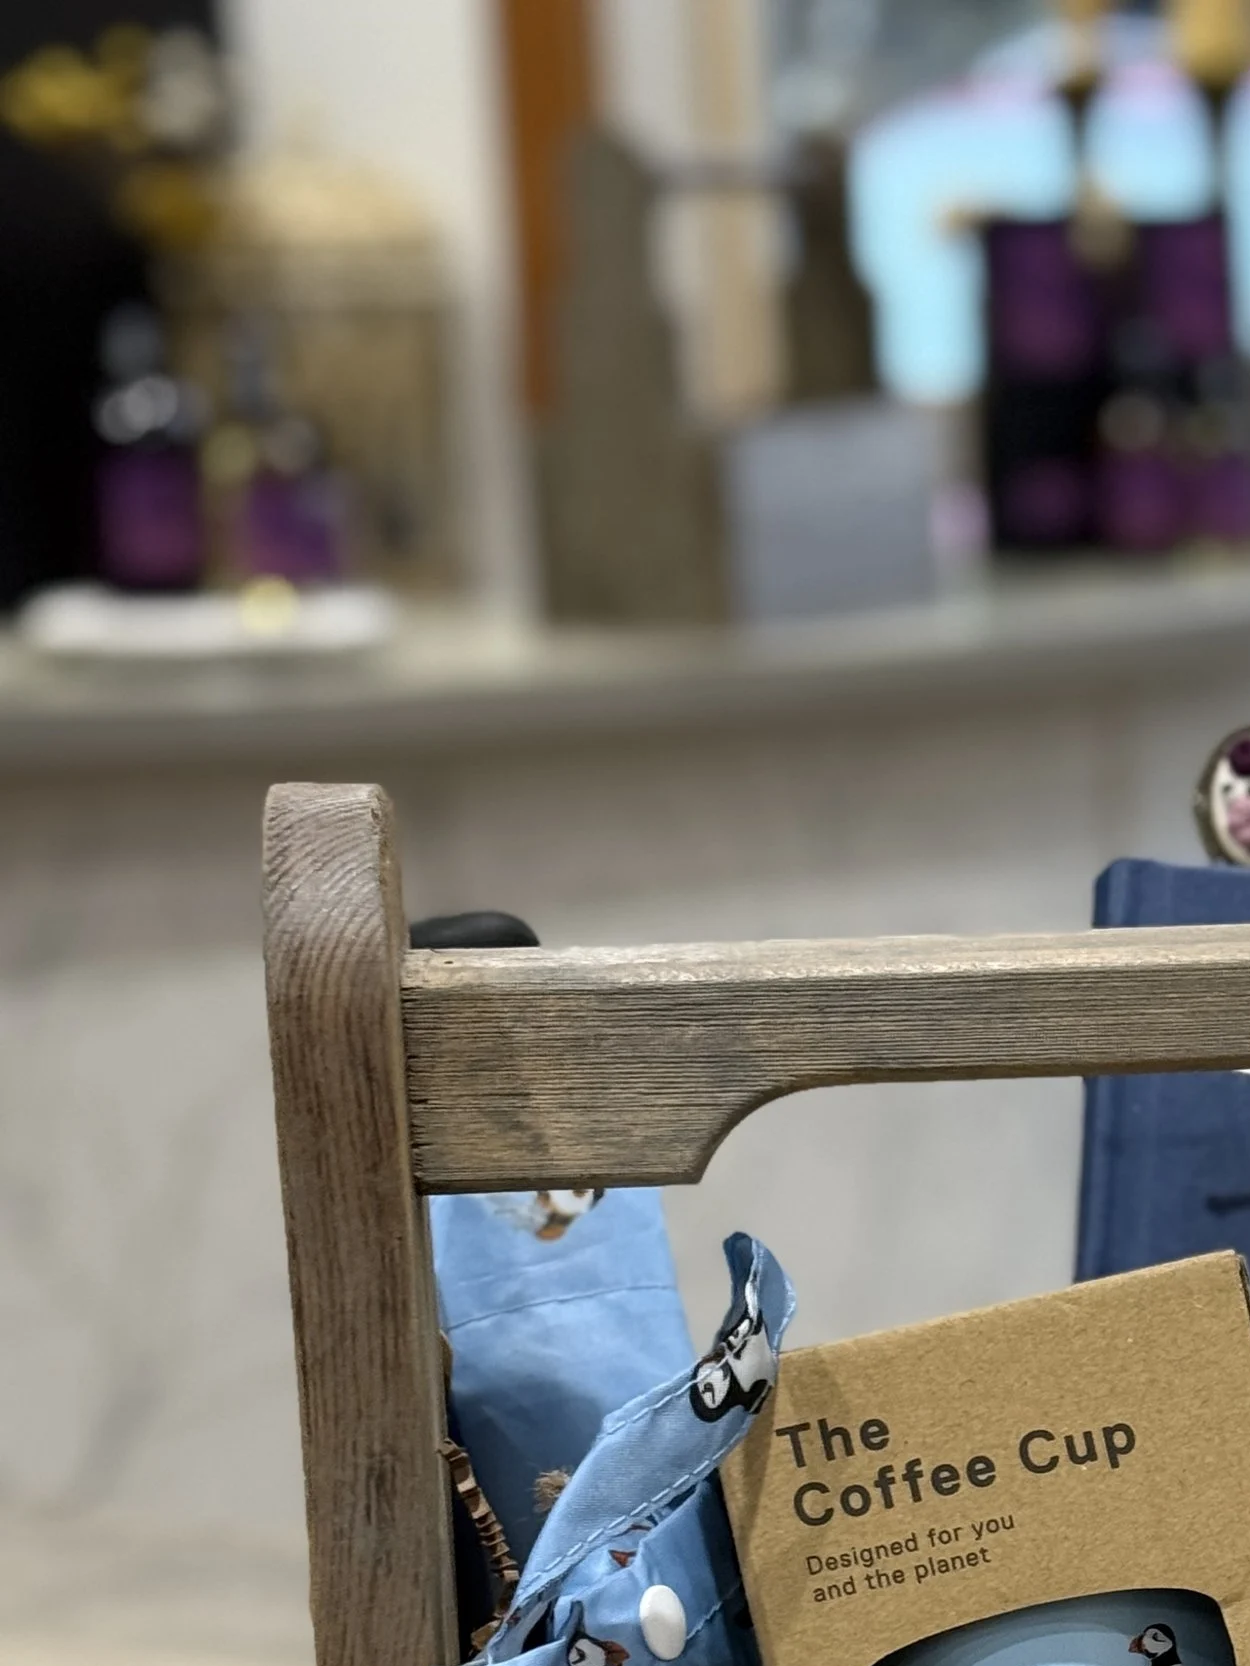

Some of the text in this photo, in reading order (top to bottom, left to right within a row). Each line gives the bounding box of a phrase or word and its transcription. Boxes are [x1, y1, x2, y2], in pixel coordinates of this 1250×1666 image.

[775, 1416, 891, 1469] The
[792, 1421, 1137, 1527] Coffee Cup
[806, 1514, 1015, 1576] Designed for you
[812, 1546, 992, 1602] and the planet
